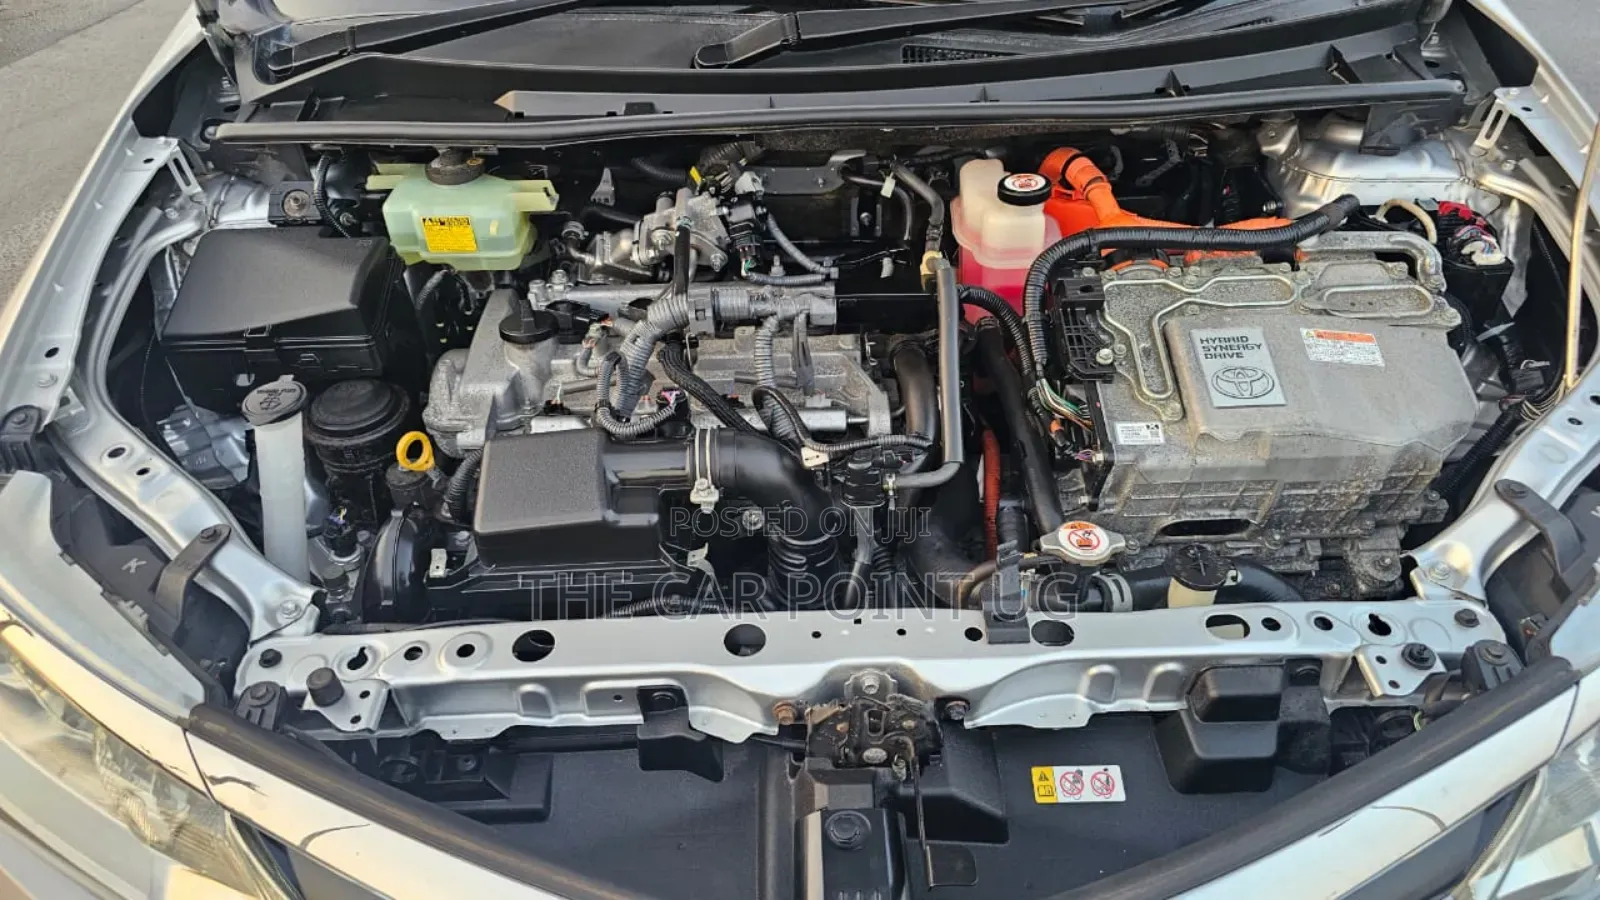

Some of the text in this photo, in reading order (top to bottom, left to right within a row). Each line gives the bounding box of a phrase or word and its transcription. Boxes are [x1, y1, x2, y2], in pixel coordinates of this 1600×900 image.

[1199, 335, 1249, 344] HYBRID
[1201, 343, 1262, 352] SYNERGY
[1203, 352, 1245, 360] DRIVE
